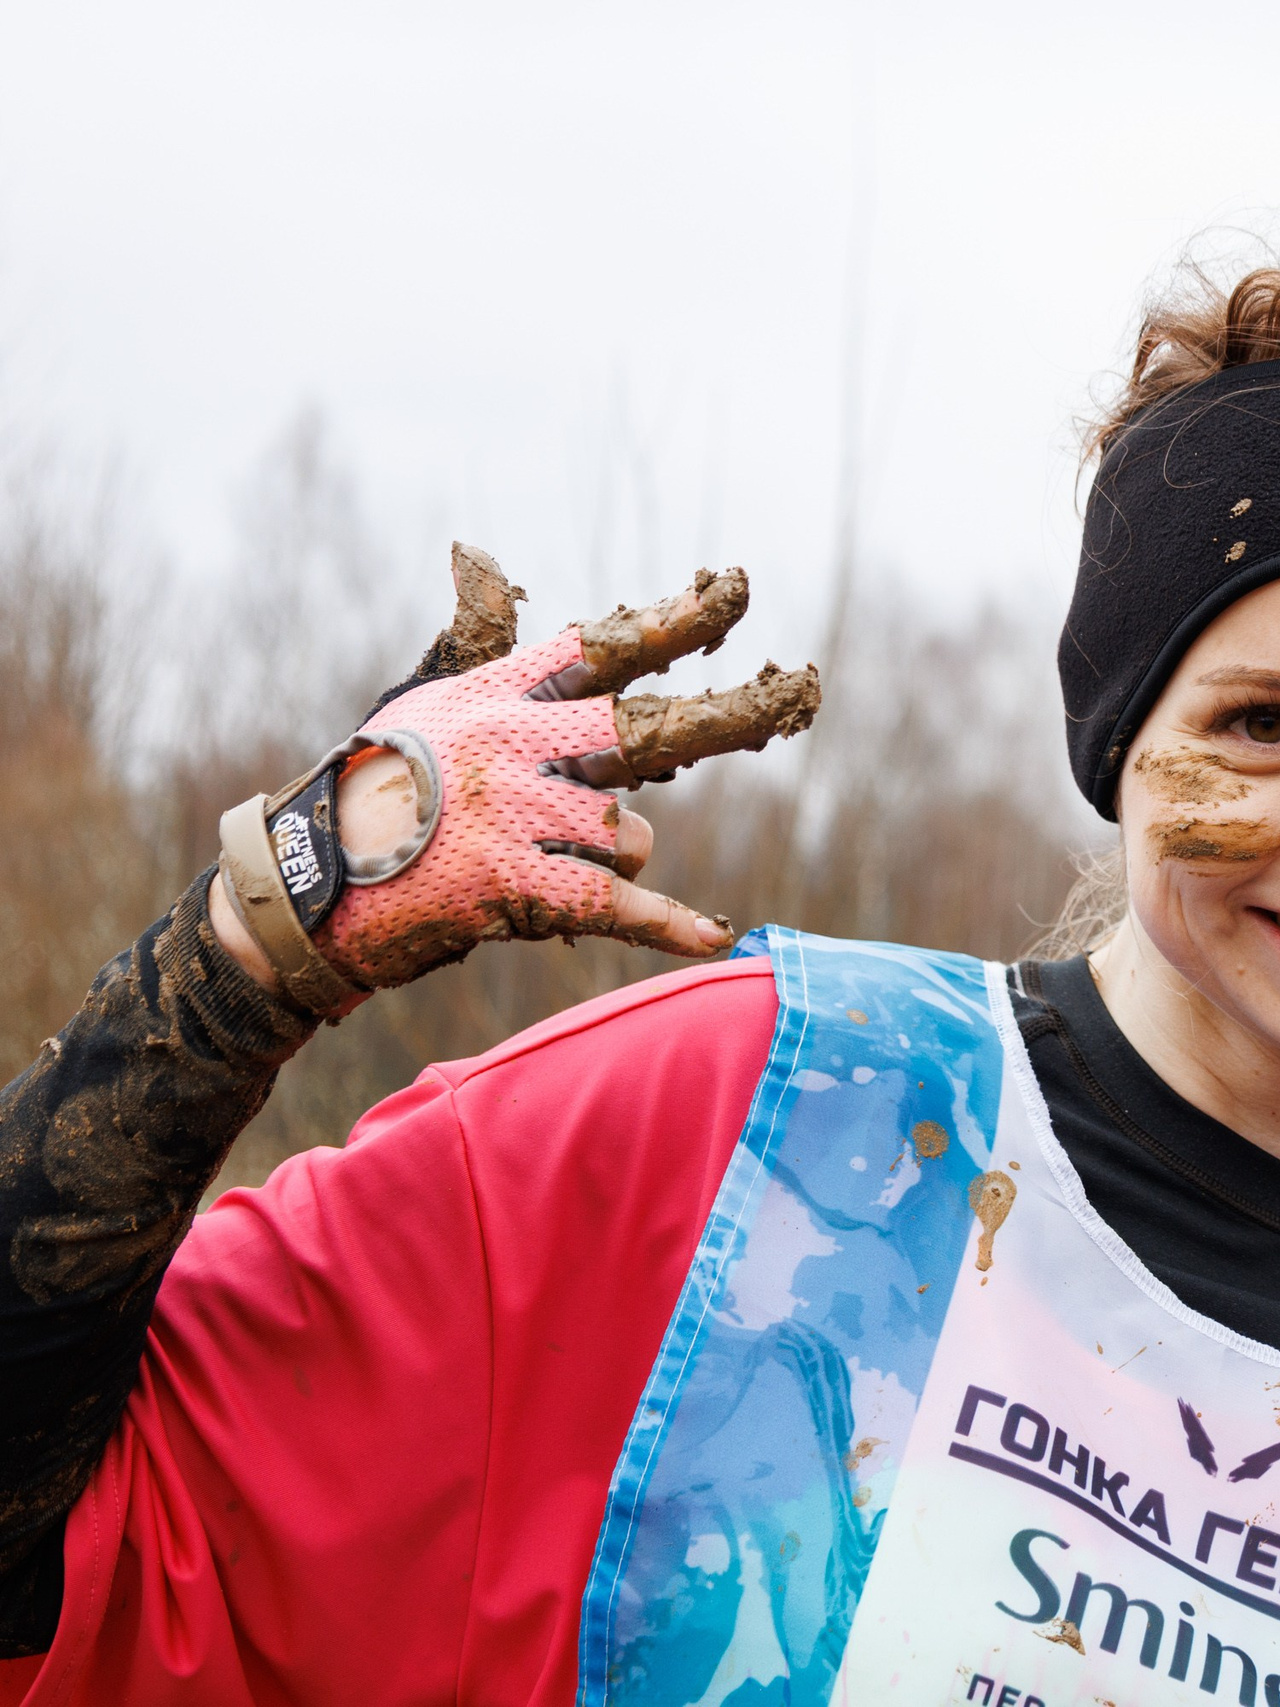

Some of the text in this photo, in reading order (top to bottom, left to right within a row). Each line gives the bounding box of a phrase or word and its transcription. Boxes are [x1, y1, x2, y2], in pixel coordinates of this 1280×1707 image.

[271, 812, 313, 895] QUEEN
[296, 825, 323, 884] FITNESS
[955, 1384, 1171, 1545] ГОНКА
